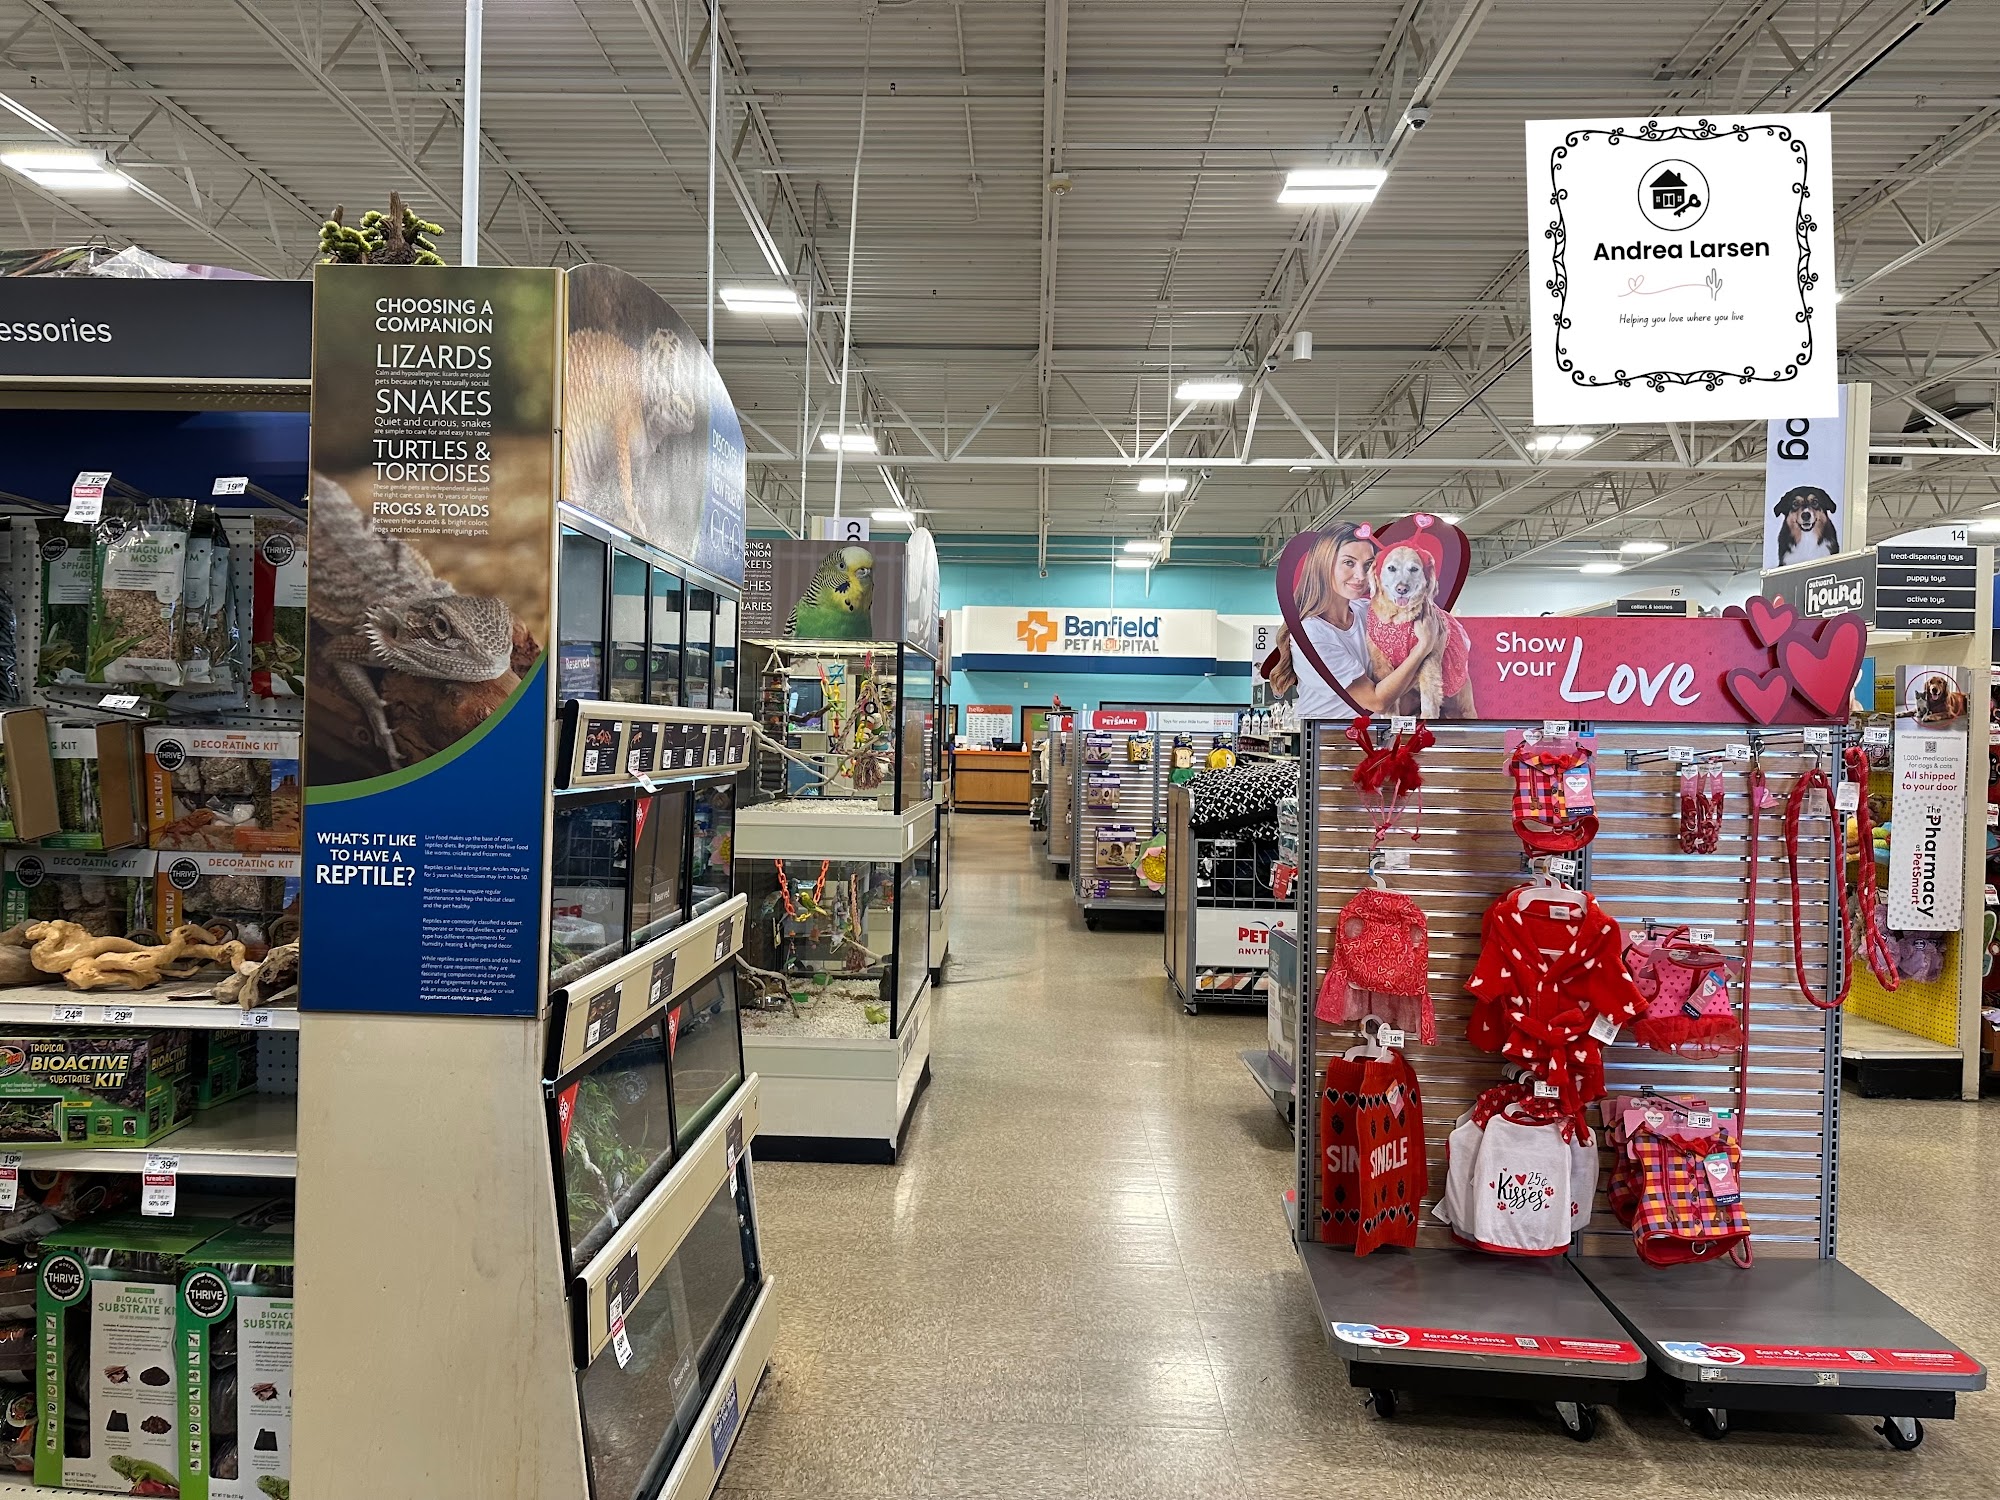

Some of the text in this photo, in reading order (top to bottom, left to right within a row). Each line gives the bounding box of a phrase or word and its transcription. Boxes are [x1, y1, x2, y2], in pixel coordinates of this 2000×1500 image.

[375, 298, 493, 315] CHOOSING A
[0, 317, 113, 346] essories
[375, 317, 493, 334] COMPANION
[376, 344, 492, 370] LIZARDS
[418, 379, 440, 387] they're
[442, 380, 470, 388] naturally
[376, 388, 492, 416] SNAKES
[374, 416, 492, 428] Quiet and curious, snakes
[385, 428, 404, 436] simple
[428, 428, 438, 436] for
[450, 430, 464, 438] easy
[372, 440, 492, 461] TURTLES &
[372, 462, 490, 483] TORTOISES
[373, 502, 490, 517] FROGS & TOADS
[448, 518, 466, 527] bright
[372, 526, 388, 534] frogs
[403, 526, 422, 534] toads
[442, 528, 472, 536] intriguing
[474, 528, 489, 536] pets.
[1951, 530, 1966, 541] 14
[266, 546, 291, 555] THRIVE
[745, 542, 764, 550] SING
[130, 554, 158, 563] MOSS
[745, 550, 772, 558] ANION
[1890, 553, 1964, 562] treat-dispensing toys
[745, 560, 772, 570] KEETS
[1808, 577, 1834, 588] outward
[1906, 575, 1946, 584] puppy toys
[744, 580, 772, 592] CHES
[1670, 588, 1680, 596] 15
[1808, 581, 1862, 613] hound
[1930, 596, 1946, 604] toys
[1064, 615, 1159, 638] Banfield
[1255, 627, 1268, 650] dog
[1496, 631, 1566, 653] Show
[1064, 638, 1160, 652] PET HPITAL
[565, 654, 590, 670] Reserved
[1496, 660, 1557, 682] your
[1560, 636, 1702, 707] Love
[1102, 716, 1138, 726] PETSMART
[193, 740, 279, 751] DECORATING KIT
[158, 751, 182, 760] THRIVE
[1918, 762, 1932, 770] dogs
[1904, 771, 1956, 782] All shipped
[1902, 782, 1958, 792] to your door
[1926, 806, 1941, 814] The
[317, 832, 417, 846] WHAT'S IT LIKE
[330, 849, 402, 863] TO HAVE A
[53, 857, 138, 869] DECORATING KIT
[208, 858, 294, 869] DECORATING KIT
[1916, 814, 1942, 919] Pharmacy
[172, 870, 196, 878] THRIVE
[316, 865, 416, 887] REPTILE?
[1910, 844, 1922, 906] at PetSmart
[654, 886, 670, 903] Reserved
[1238, 926, 1270, 944] PET
[30, 1044, 66, 1053] TROPICAL
[30, 1055, 129, 1071] BIOACTIVE
[50, 1072, 126, 1088] SUBSTRATE KIT
[1326, 1136, 1408, 1180] SIN SINGLE
[1498, 1172, 1548, 1212] Kisses 25¢
[48, 1272, 80, 1284] THRIVE
[116, 1296, 164, 1304] BIOACTIVE
[190, 1290, 223, 1301] THRIVE
[98, 1302, 160, 1314] SUBSTRATE
[244, 1320, 294, 1329] SUBSTRA
[1450, 1333, 1470, 1342] 4X
[1472, 1336, 1506, 1344] points
[1782, 1349, 1804, 1358] 4X
[1806, 1350, 1840, 1360] points
